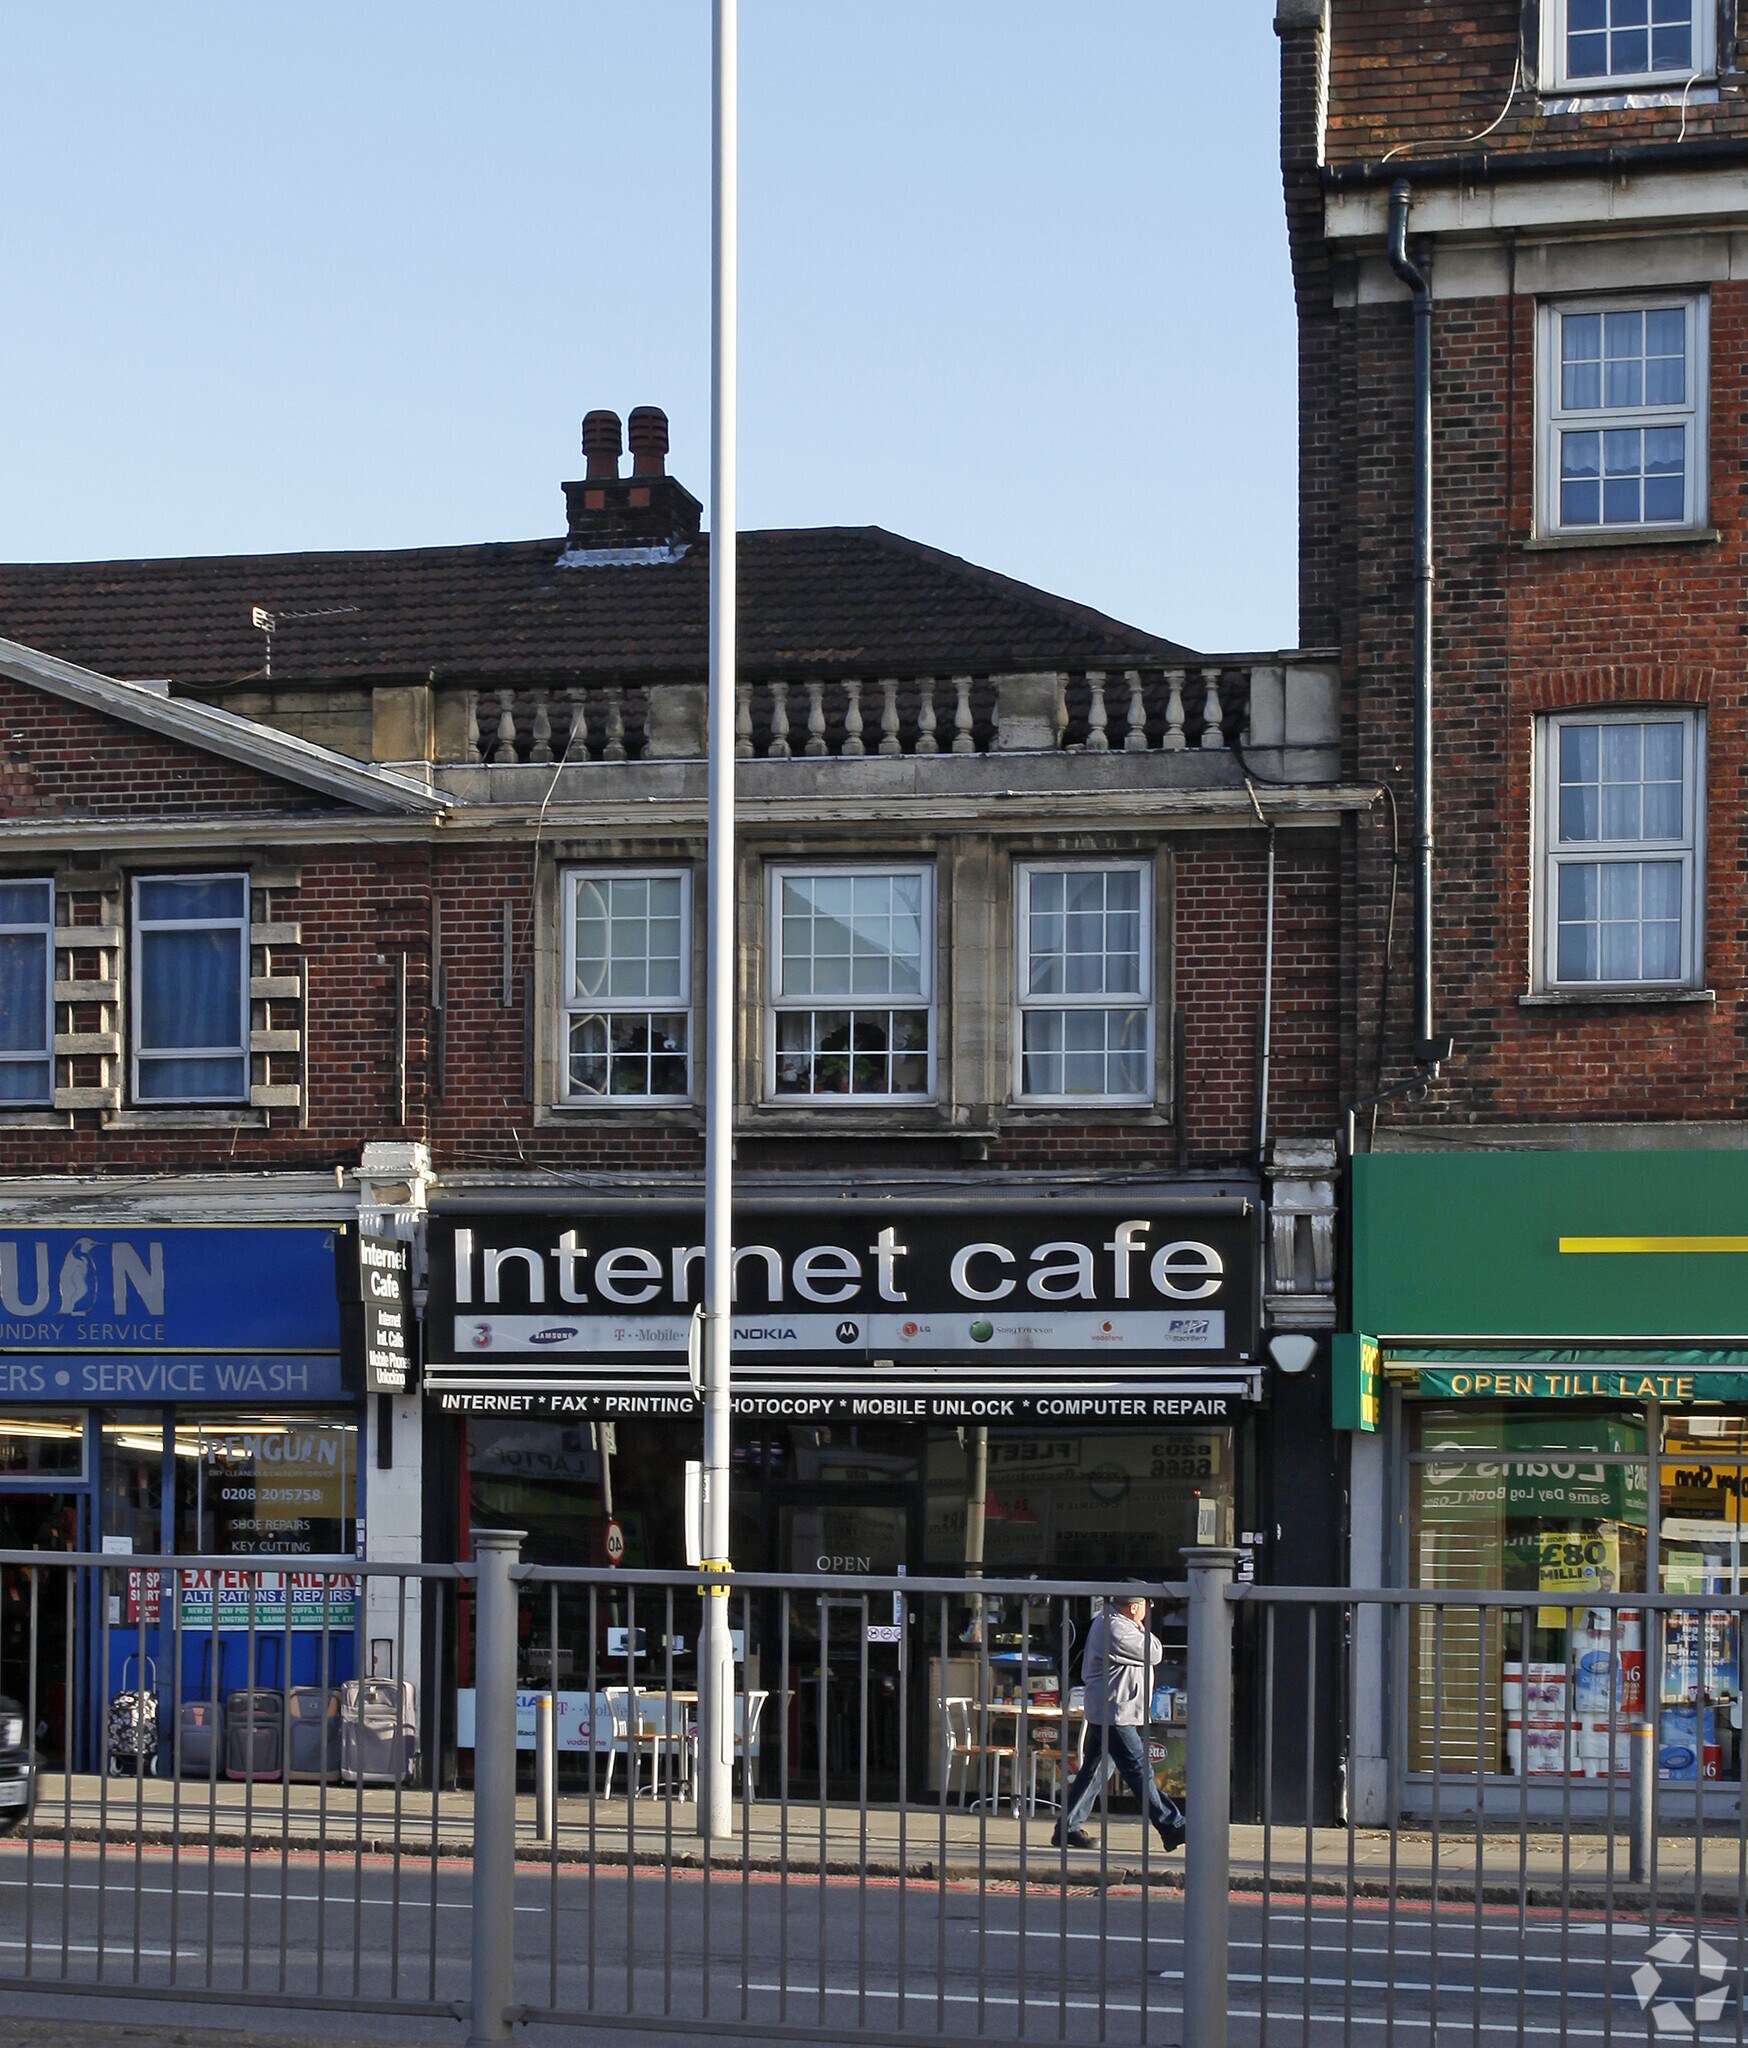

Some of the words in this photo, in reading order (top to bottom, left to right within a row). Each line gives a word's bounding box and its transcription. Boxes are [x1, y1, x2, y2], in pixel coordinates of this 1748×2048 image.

[361, 1239, 406, 1271] Internet
[454, 1226, 907, 1303] Internet
[950, 1220, 1224, 1300] cafe
[371, 1270, 400, 1299] Cafe
[0, 1324, 64, 1340] NDRY
[78, 1324, 165, 1341] SERVICE
[734, 1328, 797, 1340] NOKIA
[82, 1365, 205, 1391] SERVICE
[214, 1364, 309, 1391] WASH
[1451, 1373, 1534, 1396] OPEN
[1545, 1375, 1606, 1397] TILL
[1618, 1375, 1696, 1398] LATE
[441, 1394, 534, 1411] INTERNET
[551, 1396, 588, 1412] FAX
[605, 1397, 694, 1413] PRINTING
[730, 1398, 834, 1415] HOTOCOPY
[852, 1400, 926, 1416] MOBILE
[933, 1400, 1014, 1416] UNLOCK
[1036, 1400, 1147, 1416] COMPUTER
[1153, 1399, 1227, 1415] REPAIR
[222, 1488, 256, 1500] 0208
[262, 1488, 321, 1501] 2015758
[232, 1520, 262, 1531] SHOE
[266, 1520, 311, 1531] REPAIRS
[232, 1541, 256, 1551] KEY
[260, 1541, 311, 1552] CUTTING
[1539, 1540, 1607, 1567] £80
[816, 1555, 871, 1572] OPEN
[129, 1572, 160, 1588] CSP
[130, 1589, 160, 1601] SRT
[263, 1606, 286, 1614] REMAK
[182, 1615, 213, 1623] GARMENT
[263, 1615, 297, 1623] GARMETS
[1625, 1665, 1641, 1682] 16
[1149, 1746, 1166, 1758] etta
